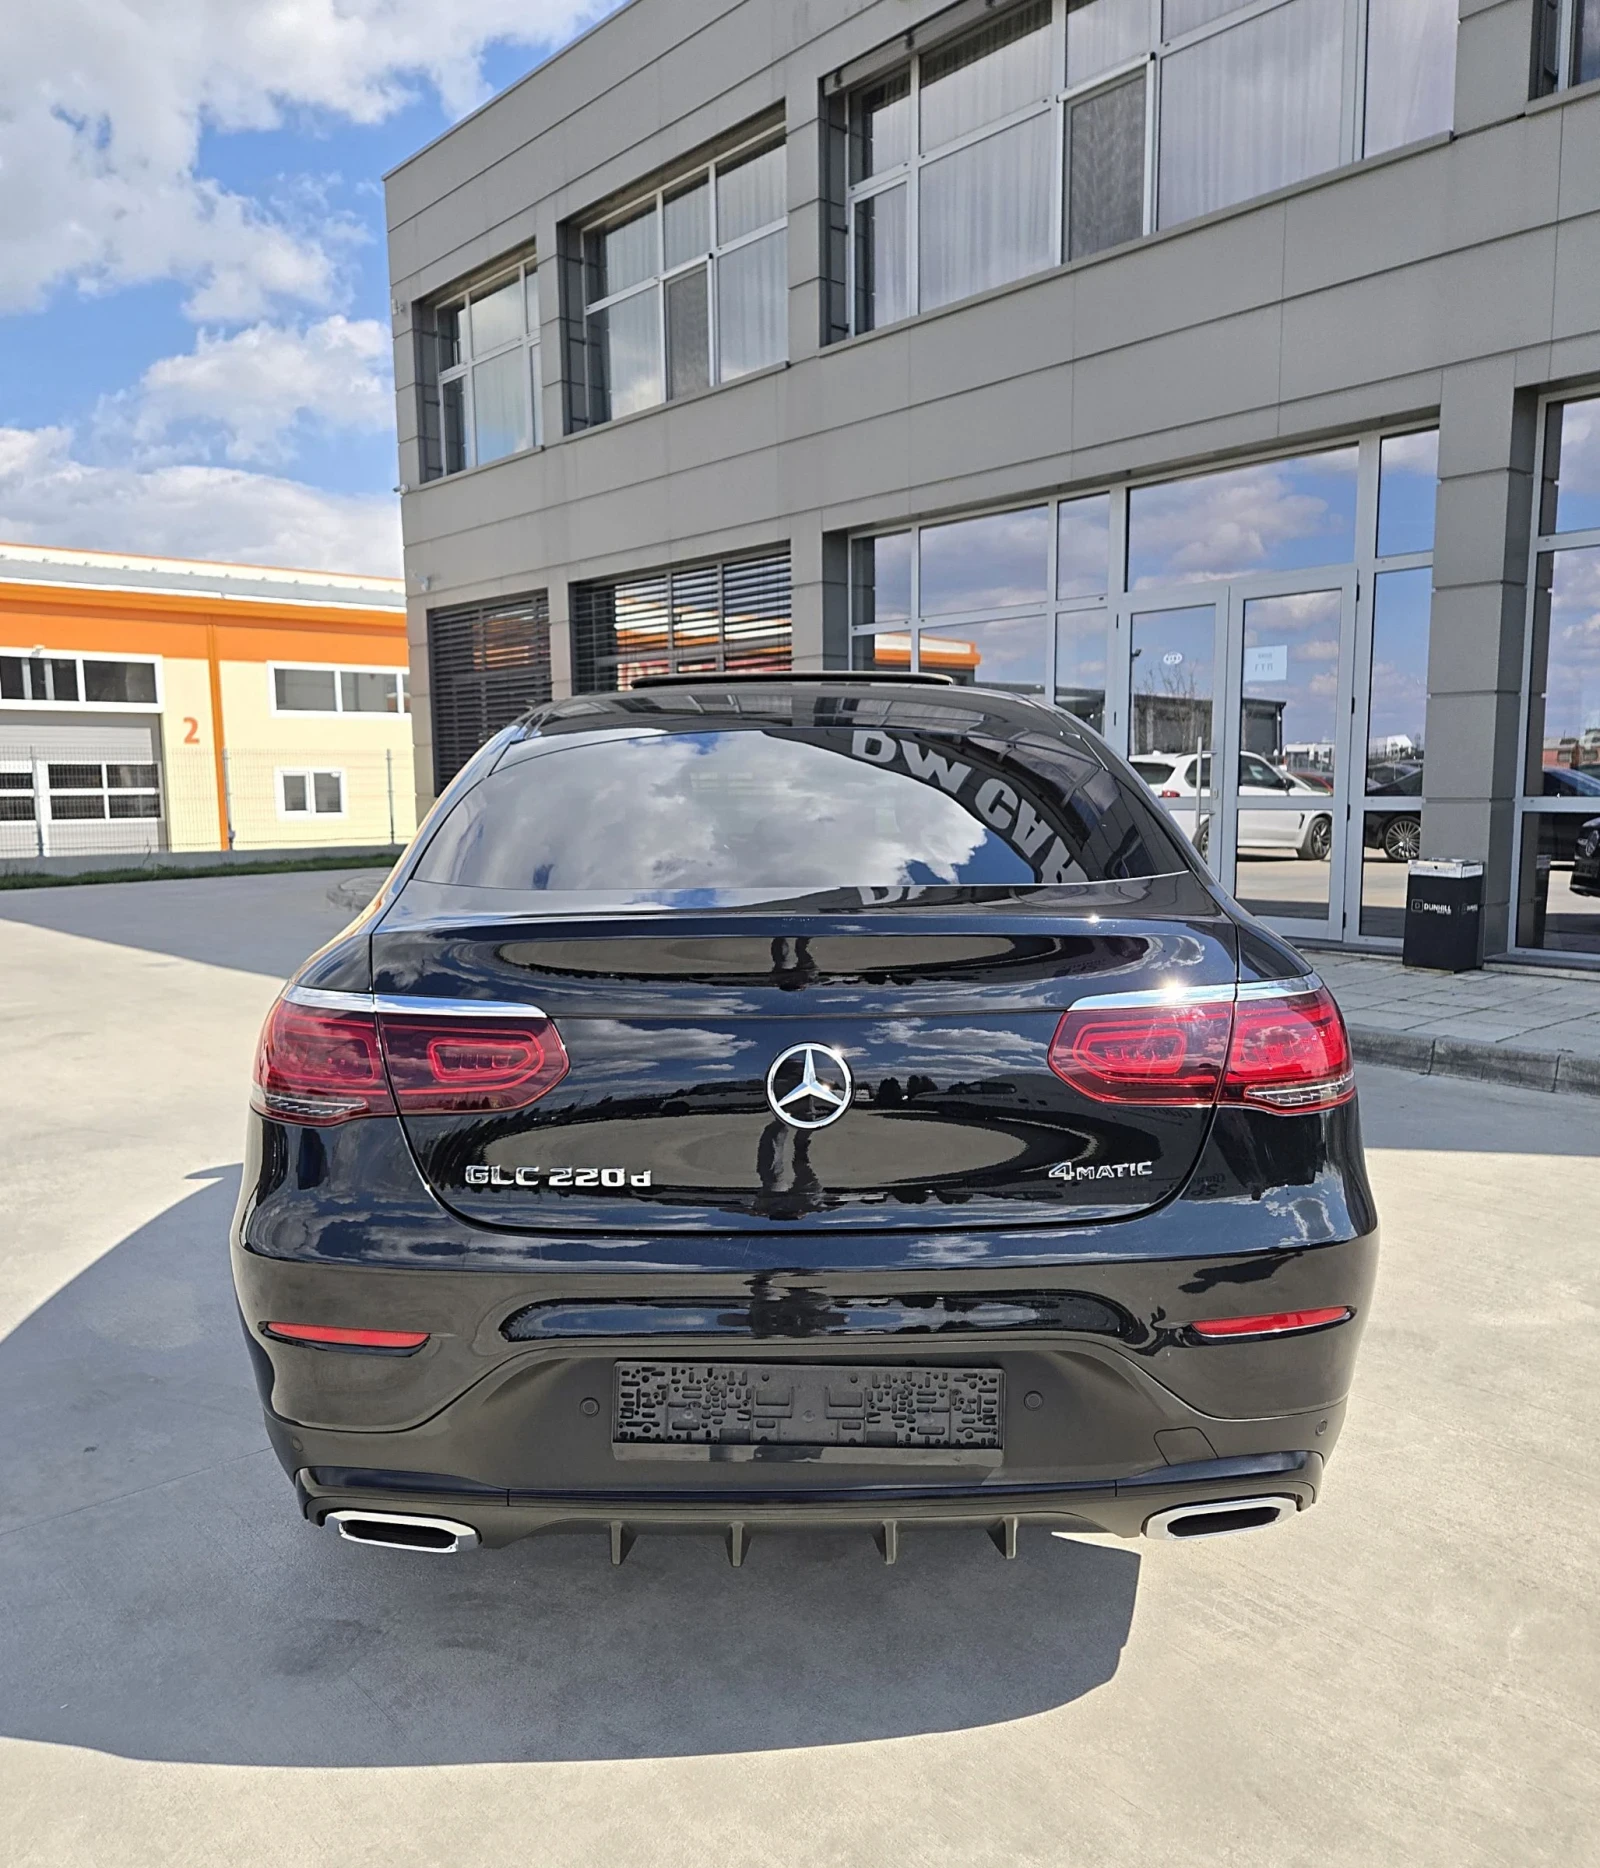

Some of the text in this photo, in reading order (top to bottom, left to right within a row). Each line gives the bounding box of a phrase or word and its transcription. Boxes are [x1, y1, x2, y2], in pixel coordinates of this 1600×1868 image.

[183, 716, 200, 744] 2
[465, 1164, 540, 1186] GLC
[1048, 1161, 1153, 1180] 4MATIC
